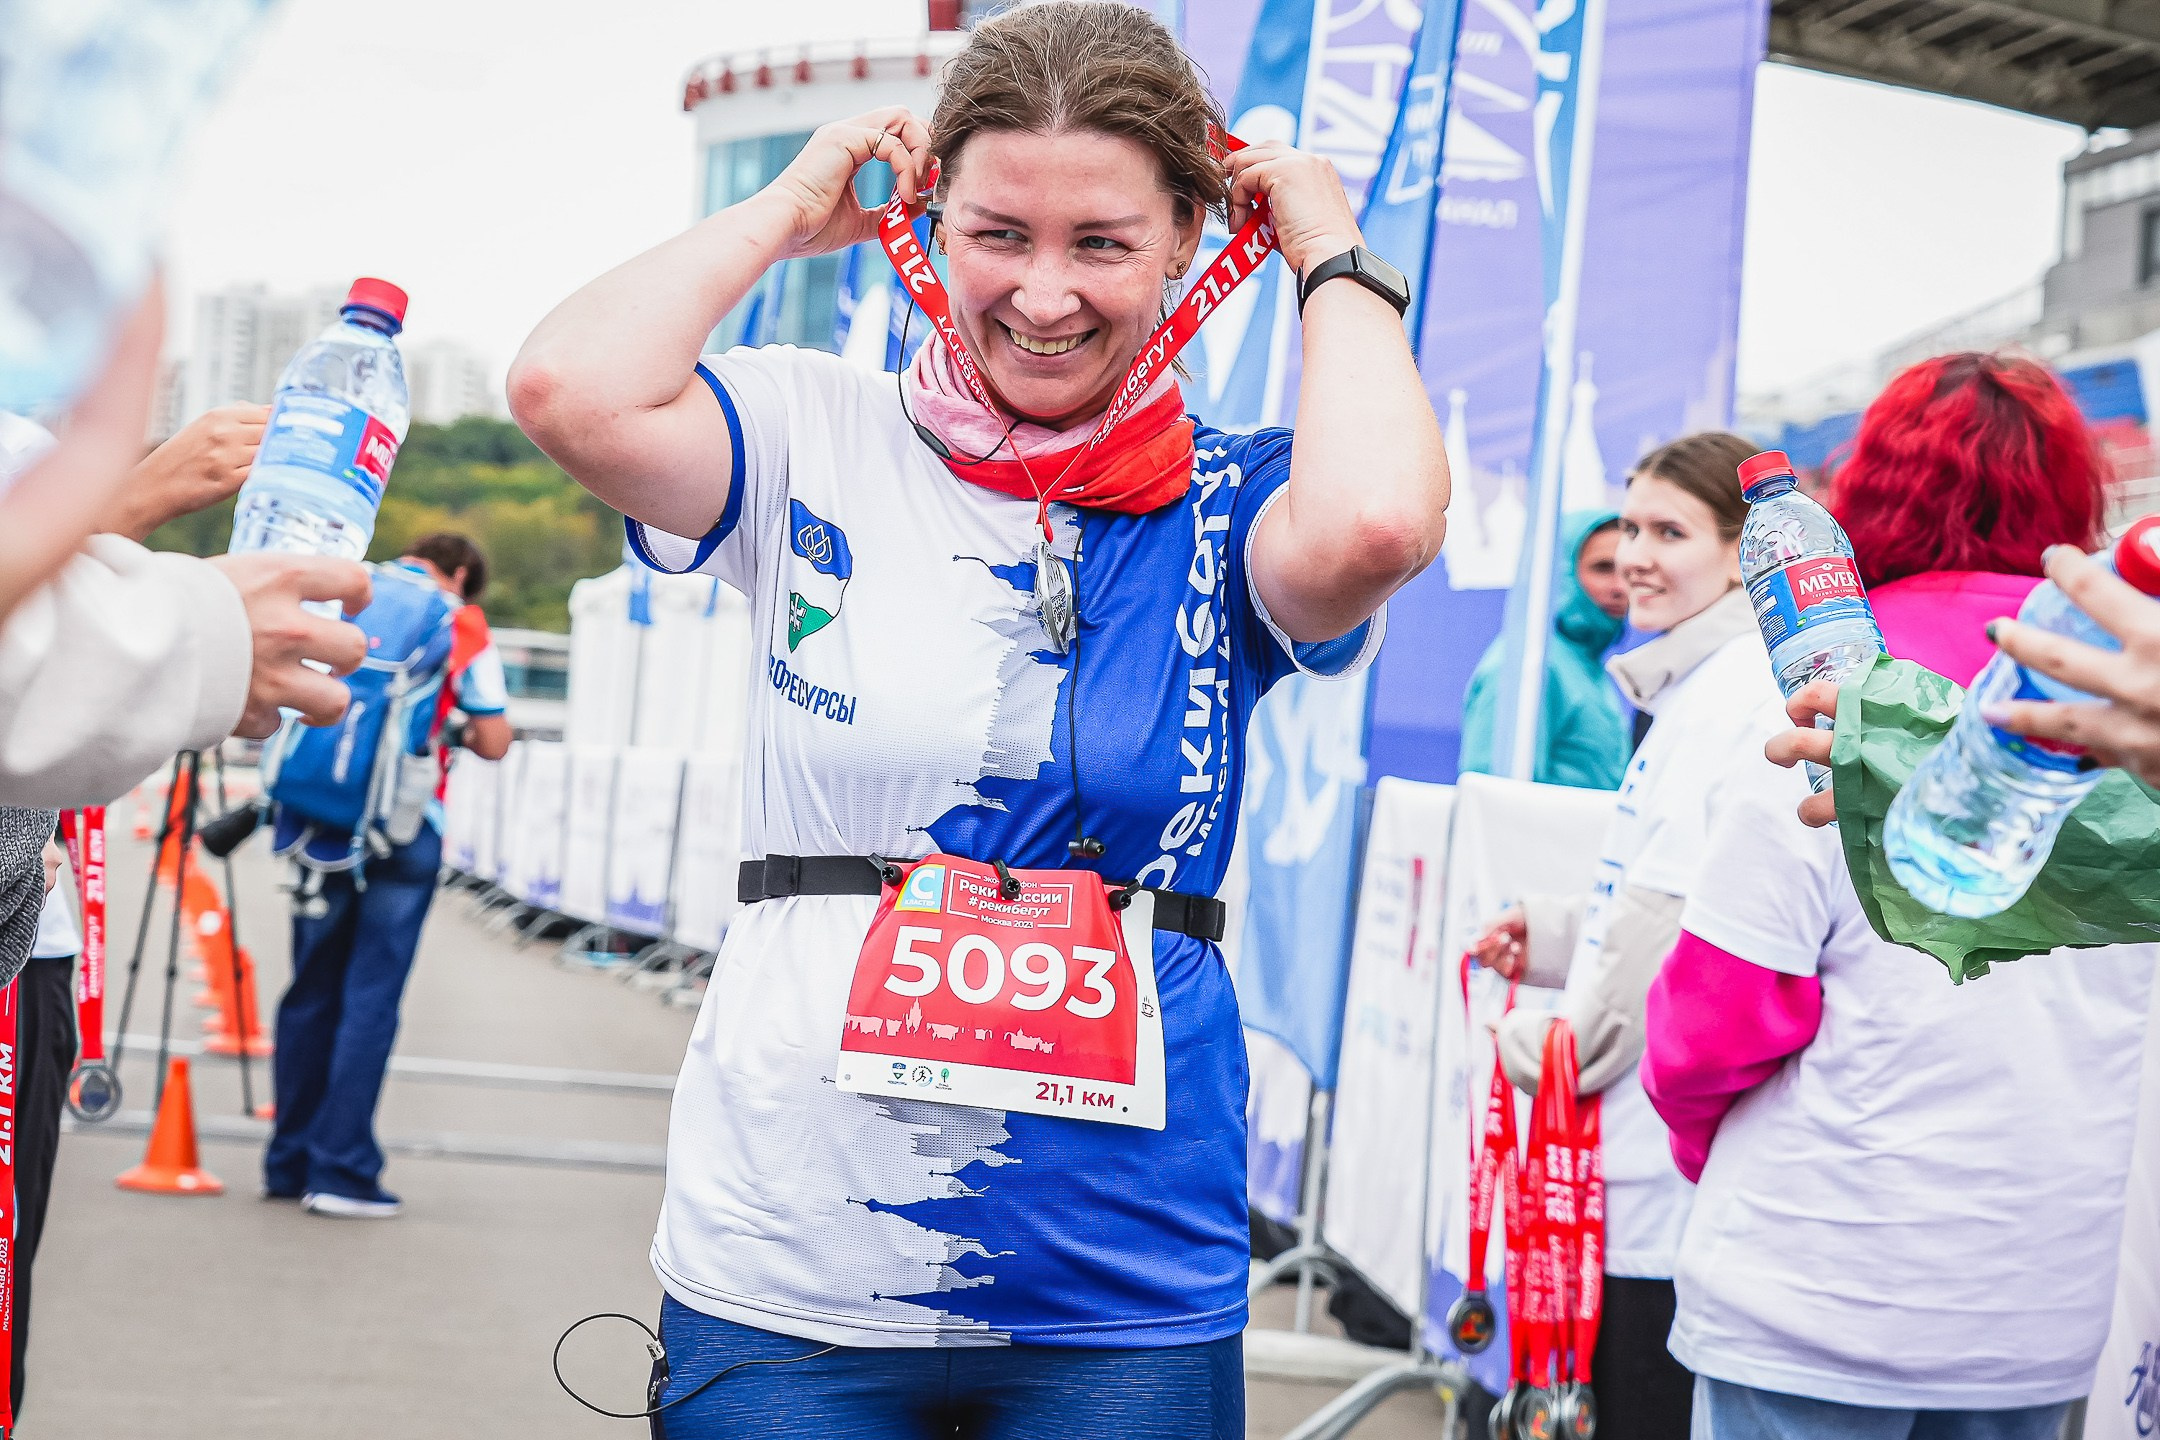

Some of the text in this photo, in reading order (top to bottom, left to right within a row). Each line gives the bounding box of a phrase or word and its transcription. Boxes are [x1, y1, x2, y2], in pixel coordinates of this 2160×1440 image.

[888, 232, 937, 294] 21.1
[1190, 254, 1241, 322] 21.1
[1089, 325, 1174, 451] рекибегут
[1129, 378, 1149, 405] 2023
[1797, 570, 1860, 596] MEVER
[959, 878, 998, 898] Реки
[968, 896, 1051, 919] #рекибегут
[980, 913, 1034, 929] Москва 2023
[883, 925, 1117, 1019] 5093
[1035, 1082, 1115, 1109] 21,1 км
